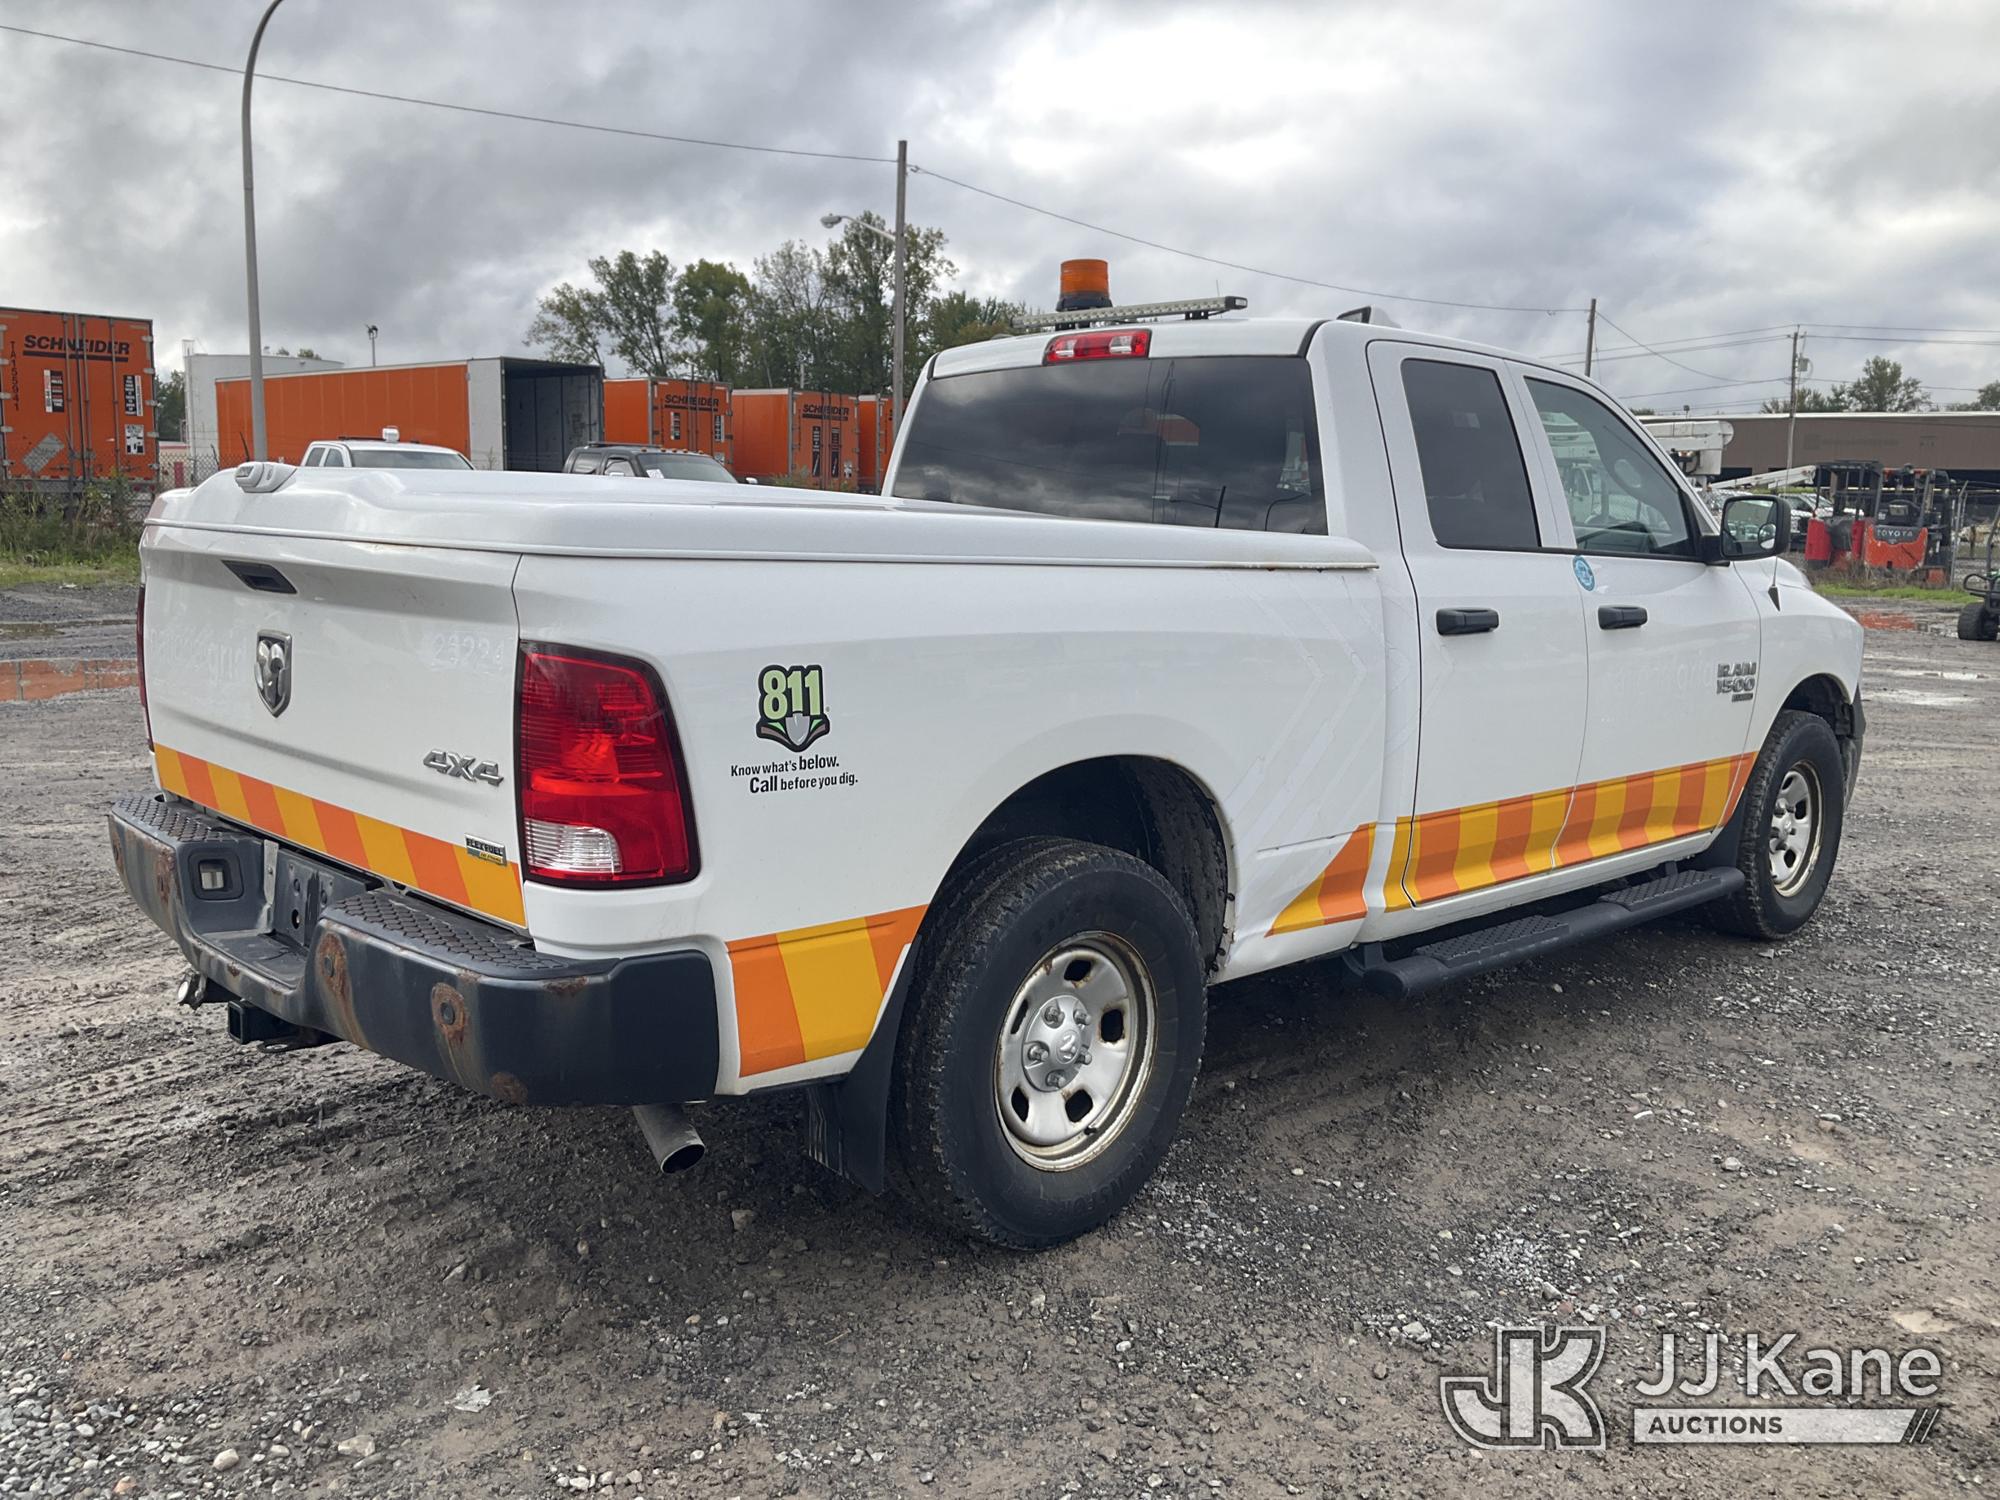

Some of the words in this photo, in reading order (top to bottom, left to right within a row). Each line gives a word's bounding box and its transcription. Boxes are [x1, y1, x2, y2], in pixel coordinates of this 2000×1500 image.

[24, 335, 130, 355] SCHNEIDER
[664, 394, 719, 407] SCHNEIDER
[803, 404, 849, 416] SCHNEIDER
[1876, 529, 1913, 537] TOYOTA
[1717, 662, 1757, 678] RAM
[760, 666, 822, 720] 811
[1716, 678, 1756, 694] 1500
[731, 764, 761, 777] Know
[762, 760, 797, 774] what's
[799, 754, 840, 771] below.
[749, 775, 778, 794] Call
[780, 776, 817, 791] before
[818, 776, 837, 790] you
[839, 772, 858, 787] dig.
